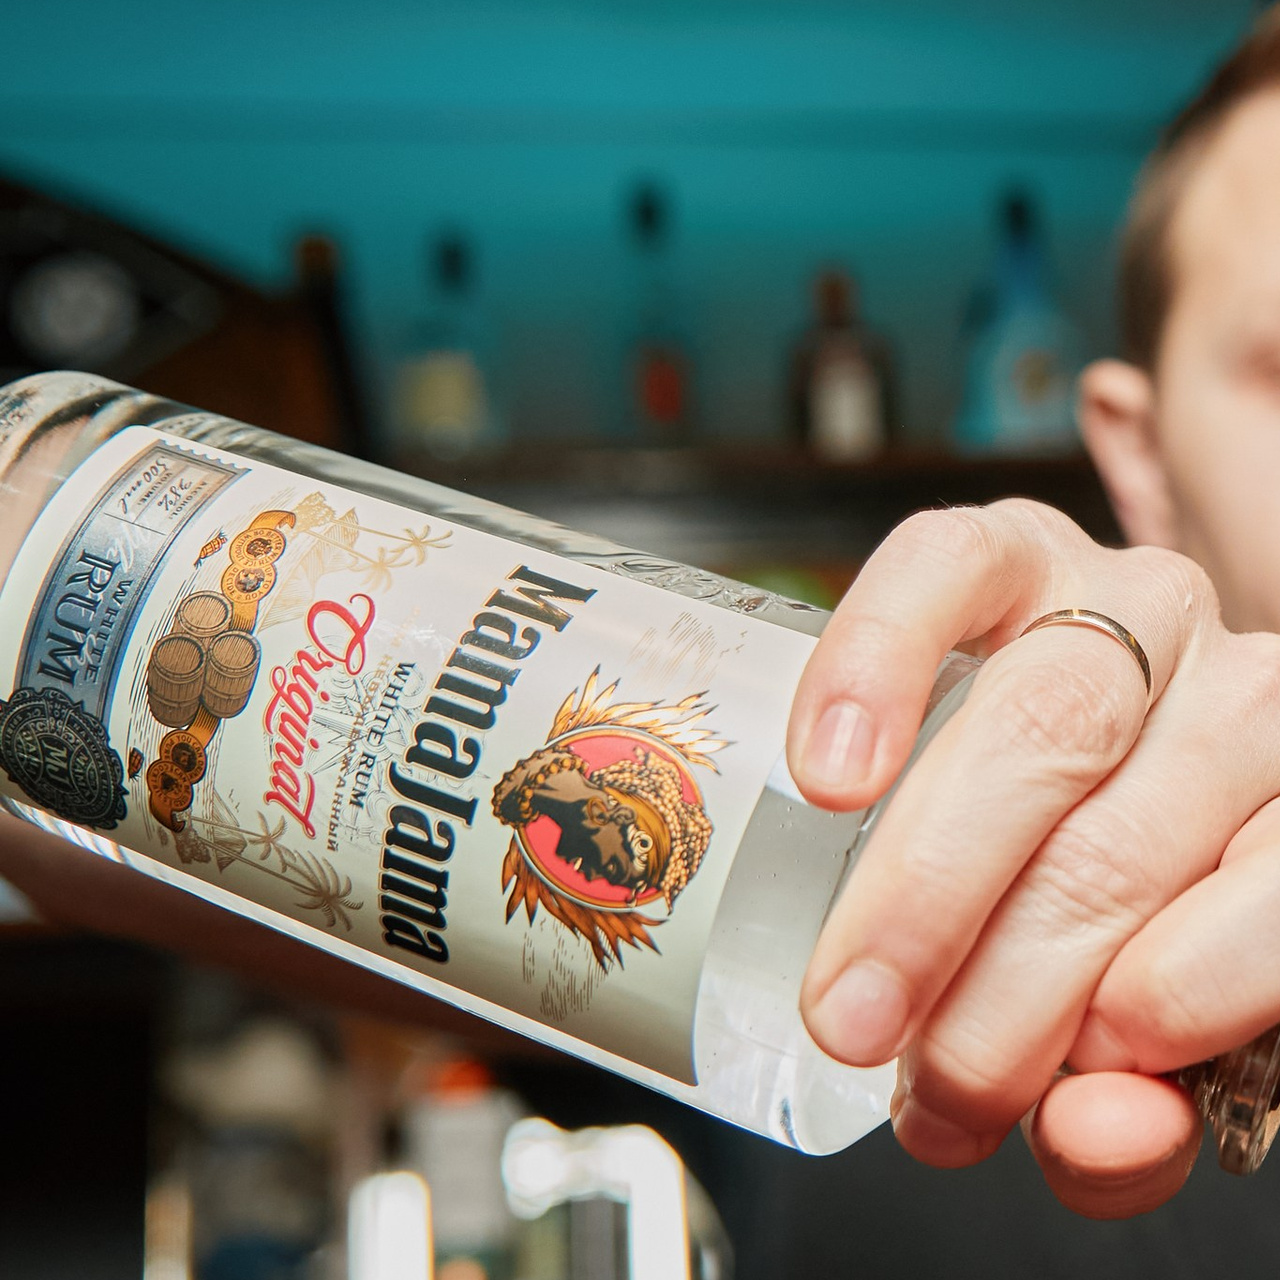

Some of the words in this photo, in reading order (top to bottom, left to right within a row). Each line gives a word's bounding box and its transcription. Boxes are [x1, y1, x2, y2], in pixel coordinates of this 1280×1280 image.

[37, 549, 121, 687] RUM
[84, 579, 133, 683] WHITE
[263, 593, 376, 839] Original
[366, 662, 416, 747] WHITE
[41, 739, 74, 789] MJ
[349, 751, 378, 810] RUM
